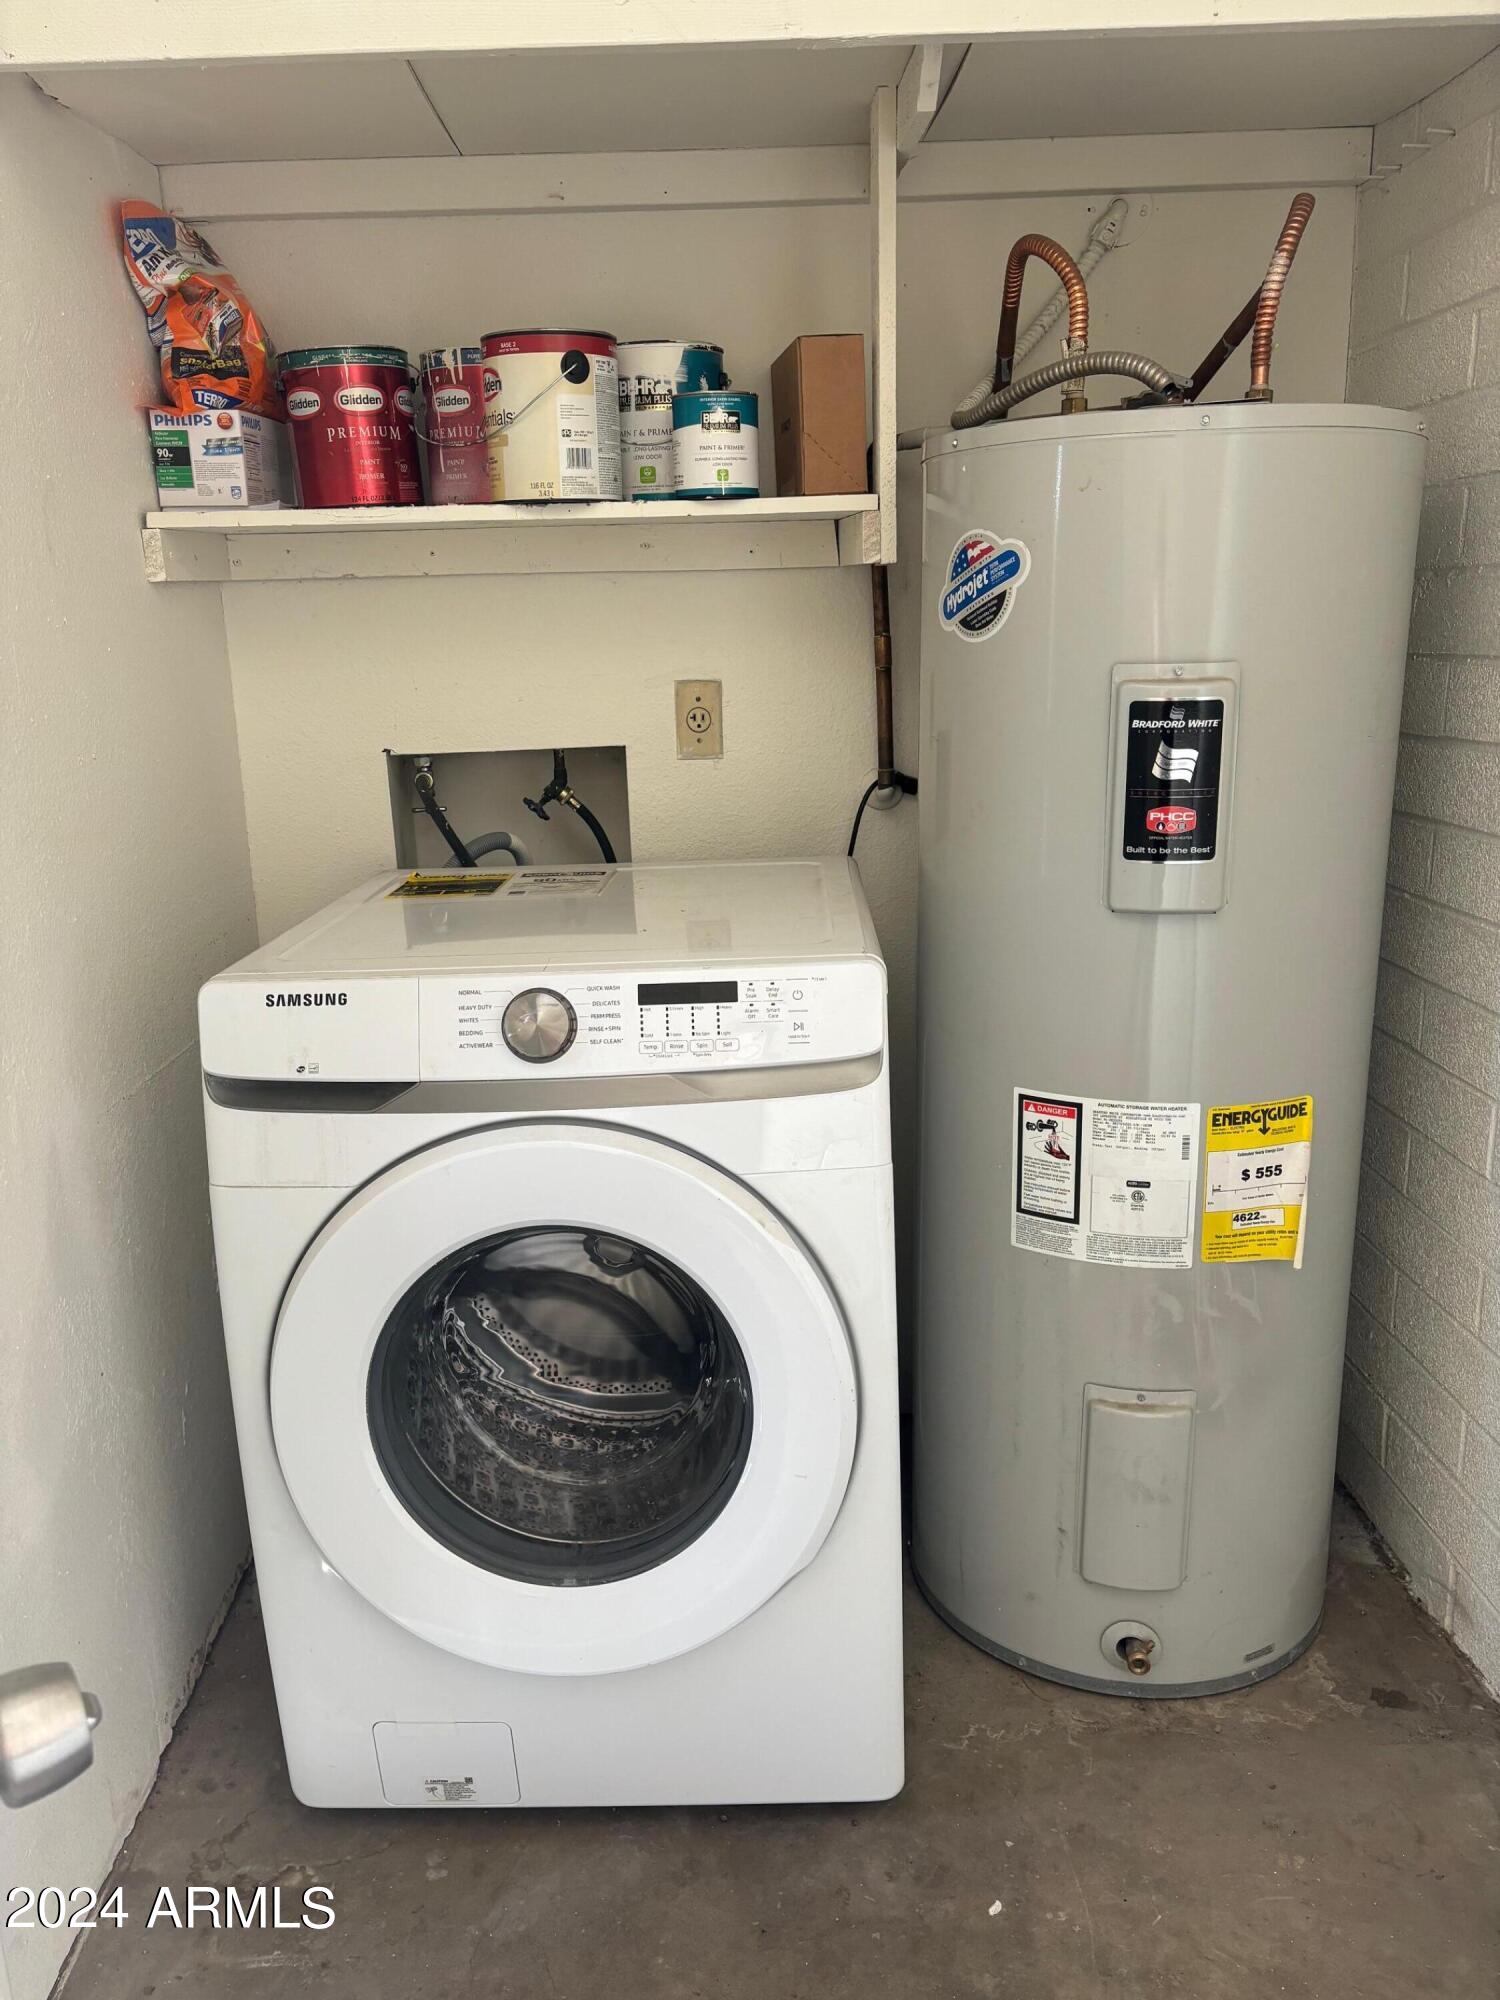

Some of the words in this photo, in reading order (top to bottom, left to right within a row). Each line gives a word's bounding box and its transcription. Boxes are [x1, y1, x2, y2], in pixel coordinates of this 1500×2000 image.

[288, 397, 319, 411] Glidden
[340, 394, 382, 406] Glidden
[436, 394, 470, 407] Glidden
[654, 395, 673, 404] PLUS
[154, 414, 213, 427] PHILIPS
[327, 425, 402, 442] PREMIUM
[429, 425, 487, 441] PREMIUM
[620, 429, 637, 438] AINT
[648, 428, 673, 437] PRIME
[946, 567, 990, 613] Hydrojet
[1131, 719, 1186, 729] BRADFORD
[1188, 719, 1220, 728] WHITE
[1149, 812, 1195, 821] PHCC
[1126, 845, 1146, 853] Built
[1173, 846, 1188, 854] the
[1190, 845, 1211, 853] Best
[265, 992, 348, 1008] SAMSUNG
[1036, 1105, 1068, 1117] DANGER
[1211, 1101, 1308, 1128] ENERGYGUIDE
[1241, 1168, 1251, 1182] $
[1255, 1164, 1283, 1179] 555
[1232, 1211, 1260, 1223] 4622
